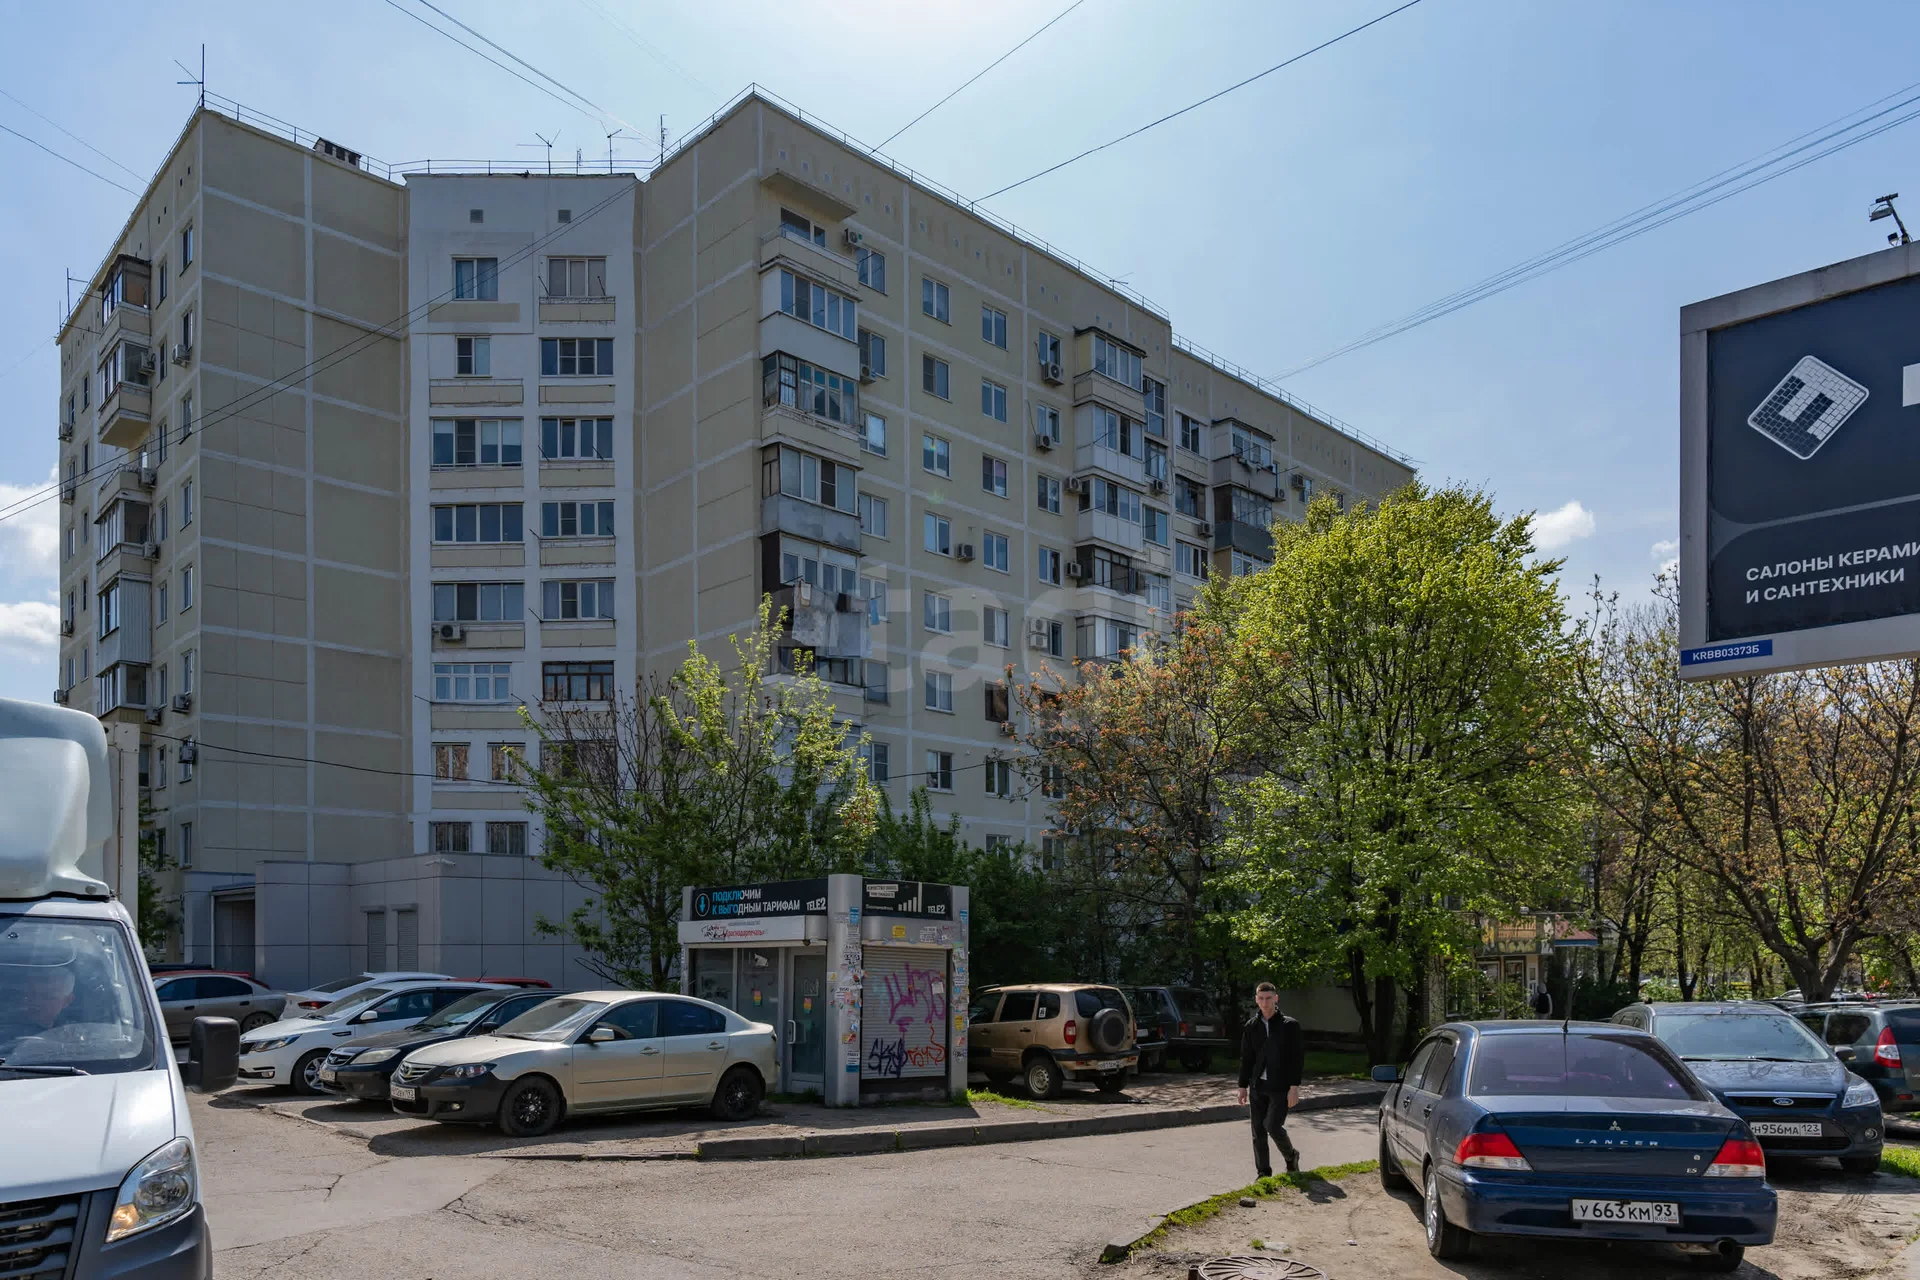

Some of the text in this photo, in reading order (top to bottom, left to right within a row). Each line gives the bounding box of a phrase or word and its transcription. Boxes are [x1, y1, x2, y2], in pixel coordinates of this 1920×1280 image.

[1746, 556, 1833, 581] САЛОНЫ
[1746, 568, 1905, 604] И САНТЕХНИКИ
[712, 889, 762, 902] ПОДКЛЮЧИМ
[712, 900, 800, 915] К ВЫГОДНЫМ ТАРИФАМ
[806, 897, 827, 911] TELE2
[927, 904, 946, 914] TELE2
[1754, 1124, 1819, 1135] Н956МА 123
[1575, 1138, 1659, 1147] LANCER
[1654, 1204, 1673, 1217] 93
